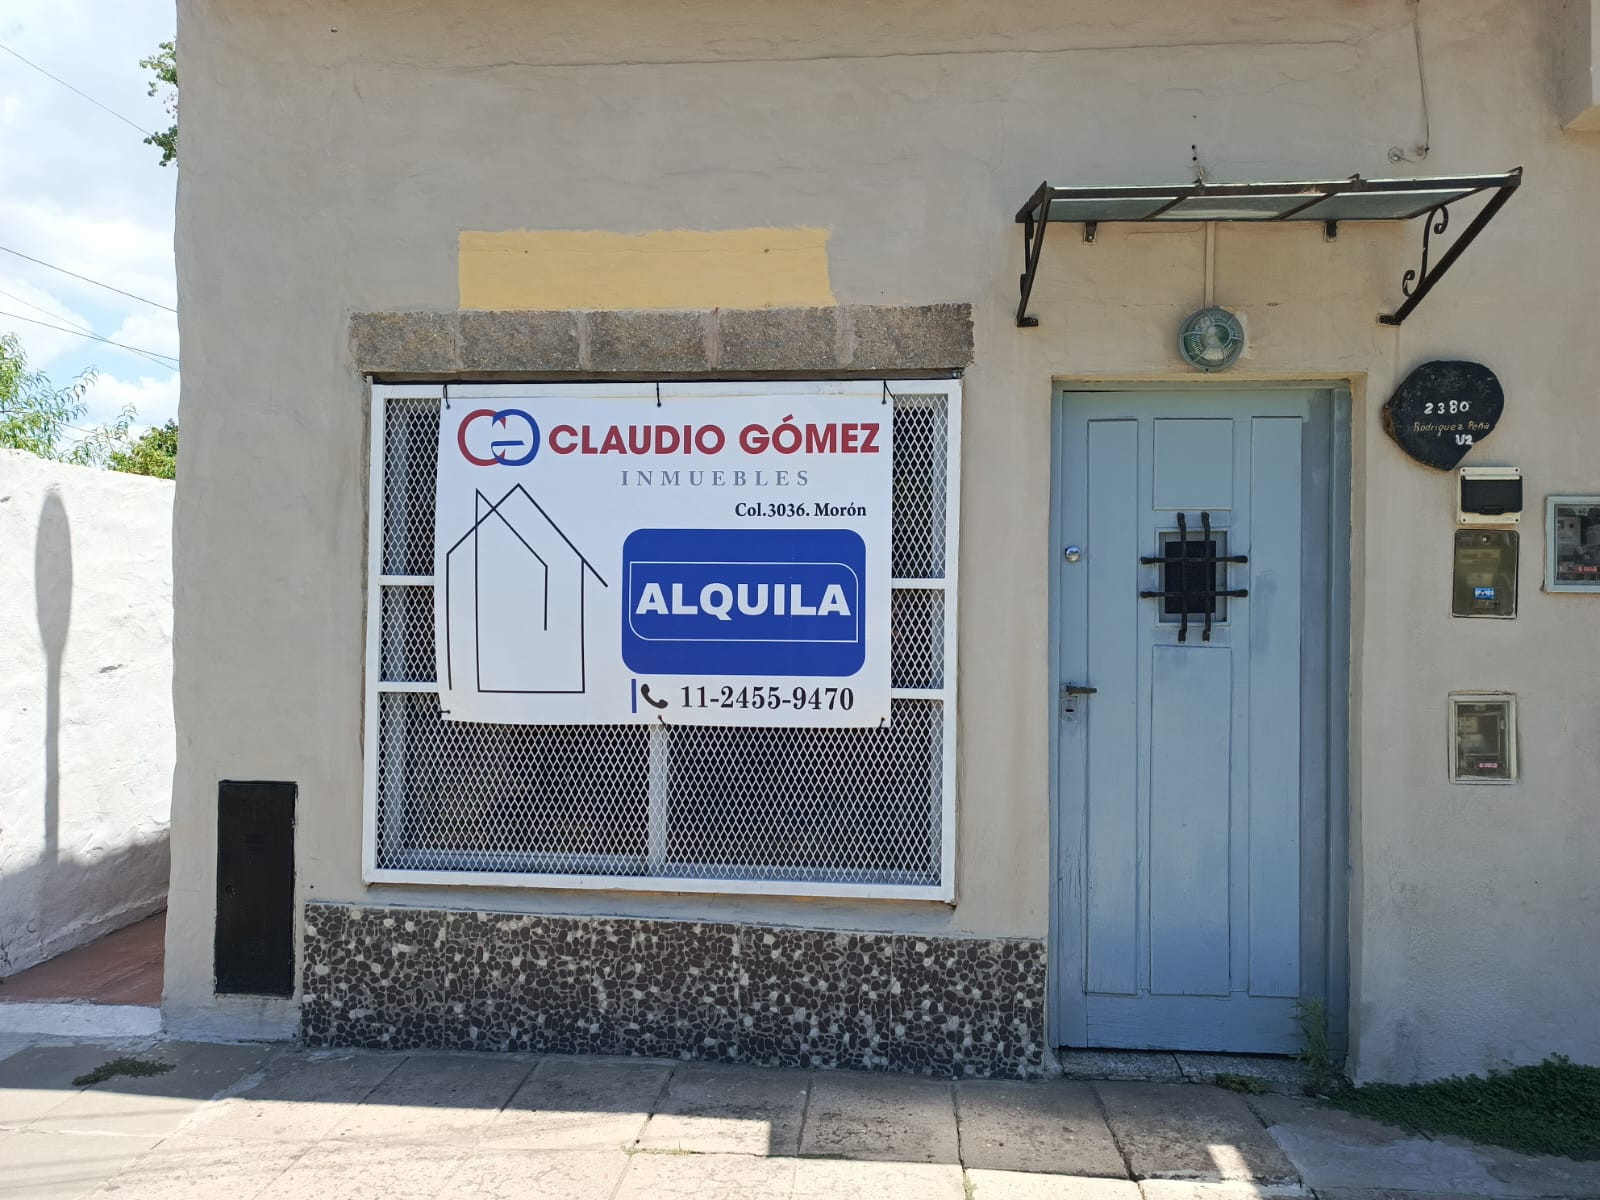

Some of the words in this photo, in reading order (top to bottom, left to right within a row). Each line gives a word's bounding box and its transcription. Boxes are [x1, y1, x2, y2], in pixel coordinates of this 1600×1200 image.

[1423, 399, 1470, 415] 2380
[548, 424, 726, 455] CLAUDIO
[738, 414, 880, 455] GÓMEZ
[620, 470, 810, 487] INMUEBLES
[734, 502, 811, 518] Col.3036.
[814, 501, 867, 518] Morón
[635, 582, 852, 621] ALQUILA
[680, 685, 855, 711] 11-2455-9470
